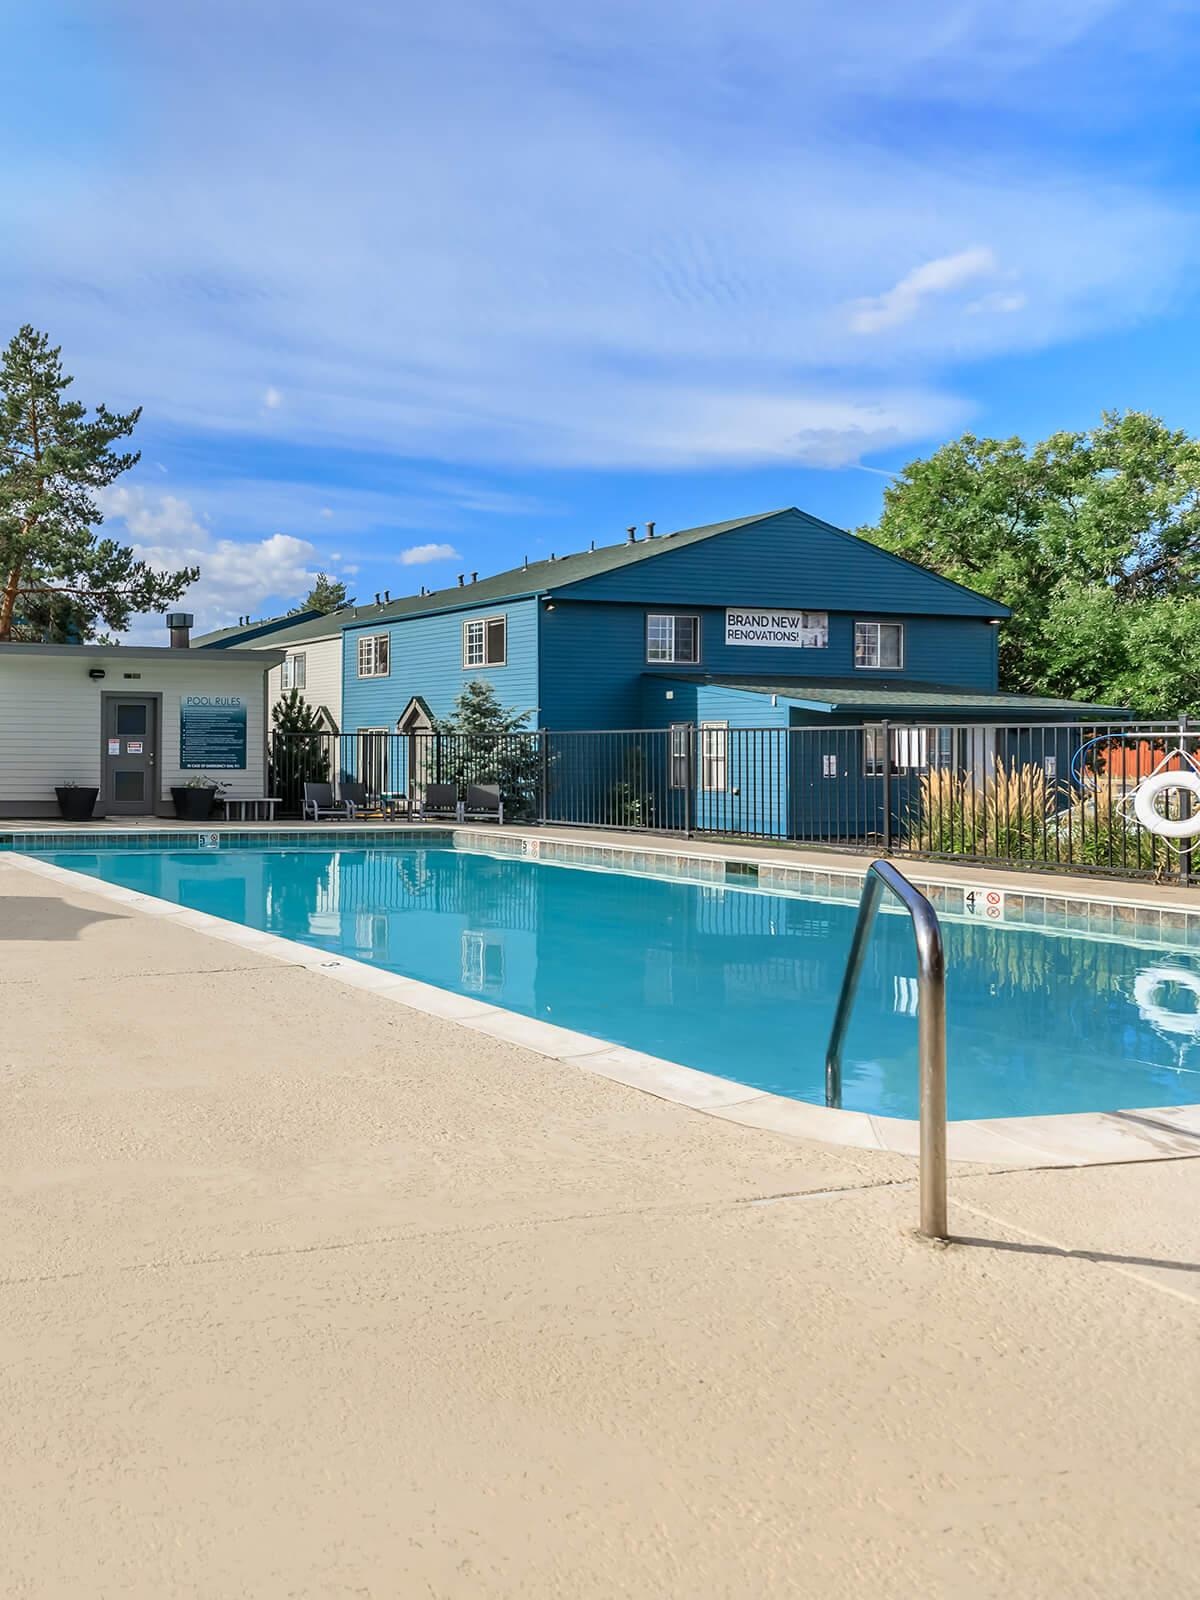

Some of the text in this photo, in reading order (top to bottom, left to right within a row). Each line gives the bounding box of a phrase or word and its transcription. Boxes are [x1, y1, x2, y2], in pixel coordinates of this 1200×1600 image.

[727, 614, 800, 629] BRAND NEW
[727, 629, 800, 641] RENOVATIONS!
[187, 696, 241, 706] POOL RULES
[522, 840, 528, 849] 5
[966, 891, 976, 904] 4
